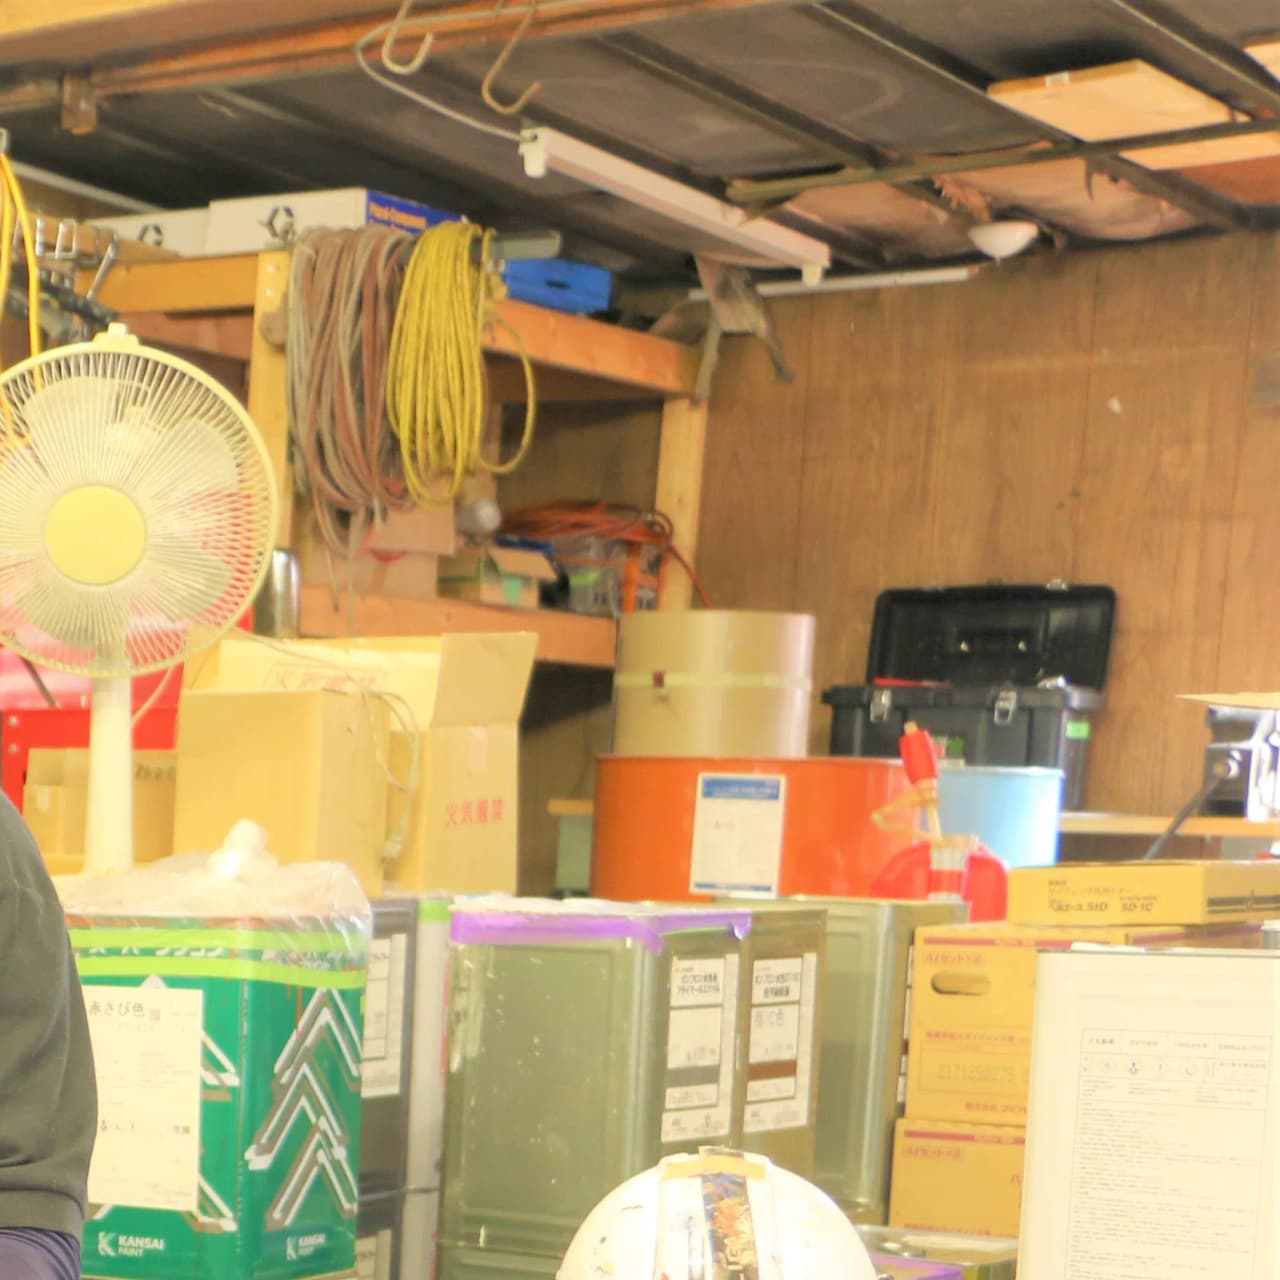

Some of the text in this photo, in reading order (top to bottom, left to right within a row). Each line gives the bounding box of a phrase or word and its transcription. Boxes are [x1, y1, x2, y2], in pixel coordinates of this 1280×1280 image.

[443, 796, 505, 829] 火気厳禁
[117, 1234, 166, 1250] KANSAI
[297, 1233, 327, 1247] KANSAI
